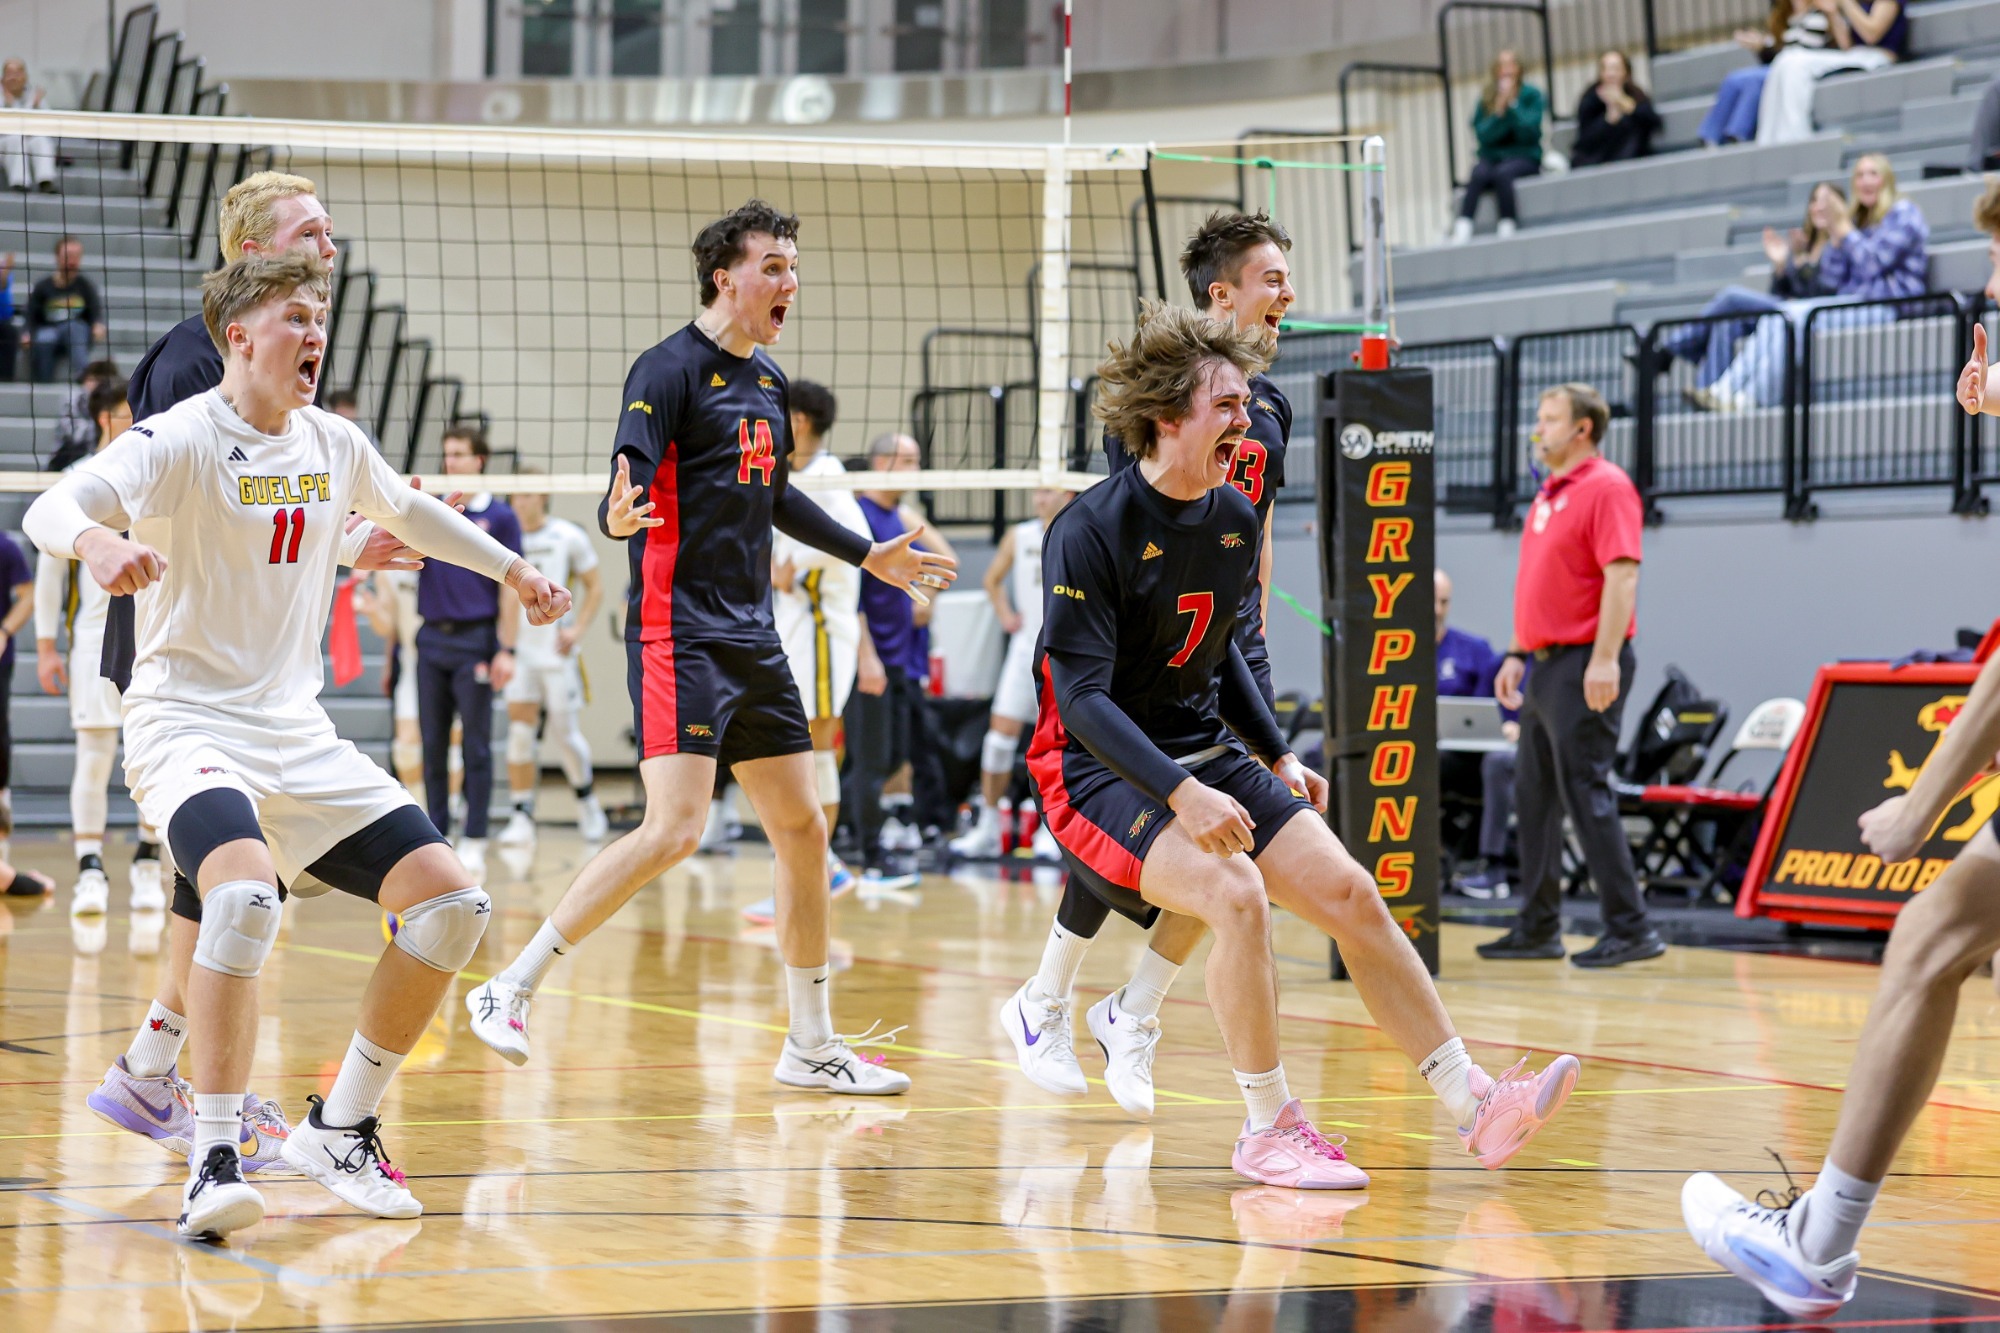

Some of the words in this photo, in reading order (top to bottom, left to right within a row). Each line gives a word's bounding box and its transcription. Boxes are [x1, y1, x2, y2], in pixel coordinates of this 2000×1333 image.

[738, 418, 776, 486] 14
[238, 472, 330, 505] GUELPH
[268, 507, 305, 564] 11
[1052, 584, 1086, 601] OUA
[1167, 591, 1215, 668] 7
[1365, 461, 1418, 897] GRYPHONS
[1774, 849, 1882, 889] PROUD
